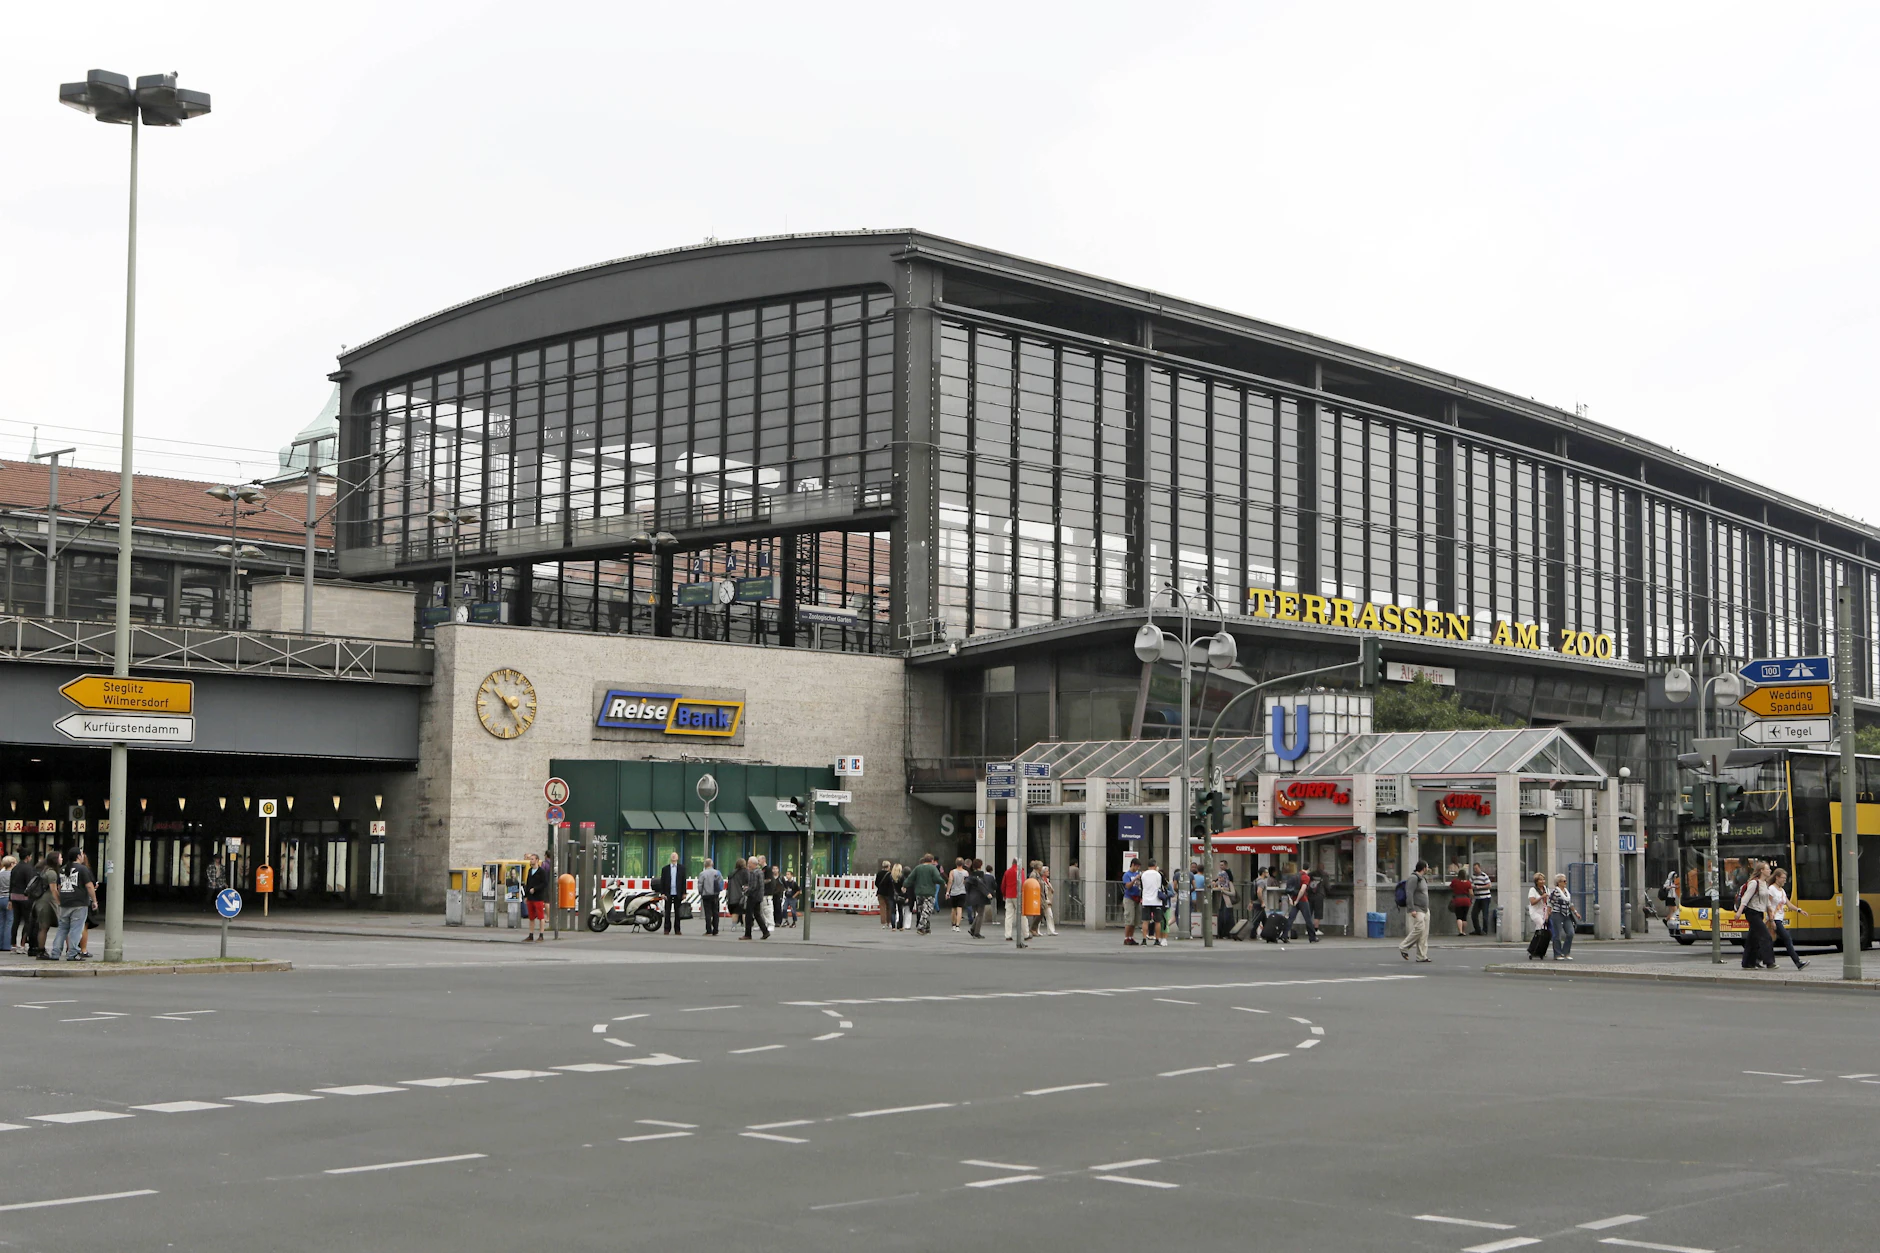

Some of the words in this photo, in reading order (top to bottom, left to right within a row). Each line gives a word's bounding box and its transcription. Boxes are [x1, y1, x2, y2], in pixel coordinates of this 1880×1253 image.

[727, 556, 734, 568] A
[764, 553, 769, 564] 1
[693, 559, 700, 571] 2
[437, 586, 442, 597] 4
[464, 583, 470, 595] A
[492, 580, 498, 592] 3
[808, 612, 837, 622] Zoologischer
[837, 616, 852, 624] Garten
[1248, 587, 1471, 641] TERRASSEN
[1492, 619, 1540, 651] AM
[1558, 627, 1612, 661] ZOO
[1764, 667, 1778, 675] 100
[103, 682, 144, 695] Steglitz
[103, 695, 170, 708] Wilmersdorf
[1769, 690, 1812, 701] Wedding
[609, 698, 668, 720] Reise
[677, 707, 730, 728] Bank
[1770, 702, 1814, 713] Spandau
[84, 721, 179, 735] Kurfürstendamm
[1272, 704, 1310, 761] U
[1785, 726, 1812, 738] Tegel
[551, 785, 558, 798] 4
[1287, 781, 1337, 799] CURRY
[1332, 791, 1350, 804] 36
[1443, 792, 1483, 810] CURRY
[940, 813, 955, 836] S
[1627, 836, 1634, 850] U
